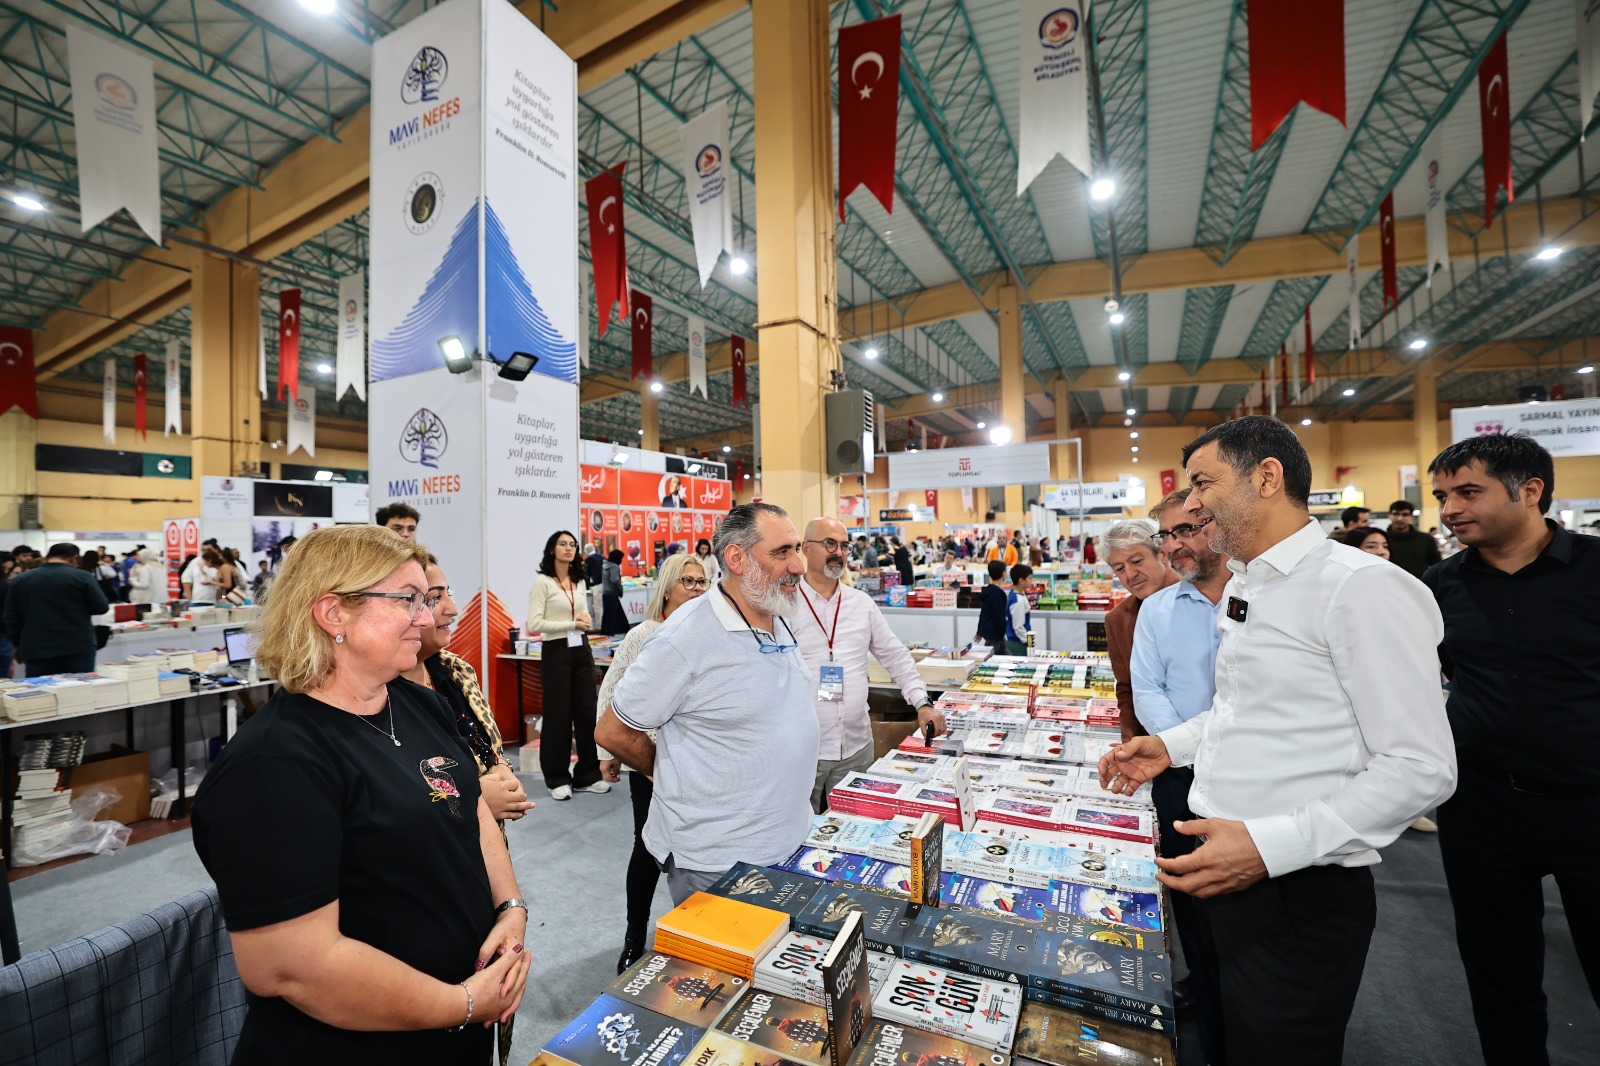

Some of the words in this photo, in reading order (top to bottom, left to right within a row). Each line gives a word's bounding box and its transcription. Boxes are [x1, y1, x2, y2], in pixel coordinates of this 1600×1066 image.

[422, 97, 461, 130] NEFES
[516, 413, 556, 432] Kitaplar,
[1520, 410, 1564, 422] SARMAL
[514, 433, 558, 448] uygarlığa
[506, 448, 523, 460] yol
[524, 450, 564, 463] gösteren
[514, 464, 558, 478] ışıklardır.
[422, 474, 461, 495] NEFES
[497, 487, 530, 498] Franklin
[530, 489, 538, 498] D.
[538, 490, 571, 500] Roosevelt
[770, 881, 796, 904] MARY
[870, 906, 892, 932] MARY
[986, 928, 1005, 957] MARY
[772, 943, 820, 975] SON
[982, 967, 1005, 978] MARY
[1120, 954, 1135, 987] MARY
[889, 974, 936, 1012] SON
[935, 974, 982, 1014] GÜN
[1120, 998, 1146, 1010] MARY
[1120, 1012, 1147, 1025] MARY
[647, 1026, 674, 1052] NASIL
